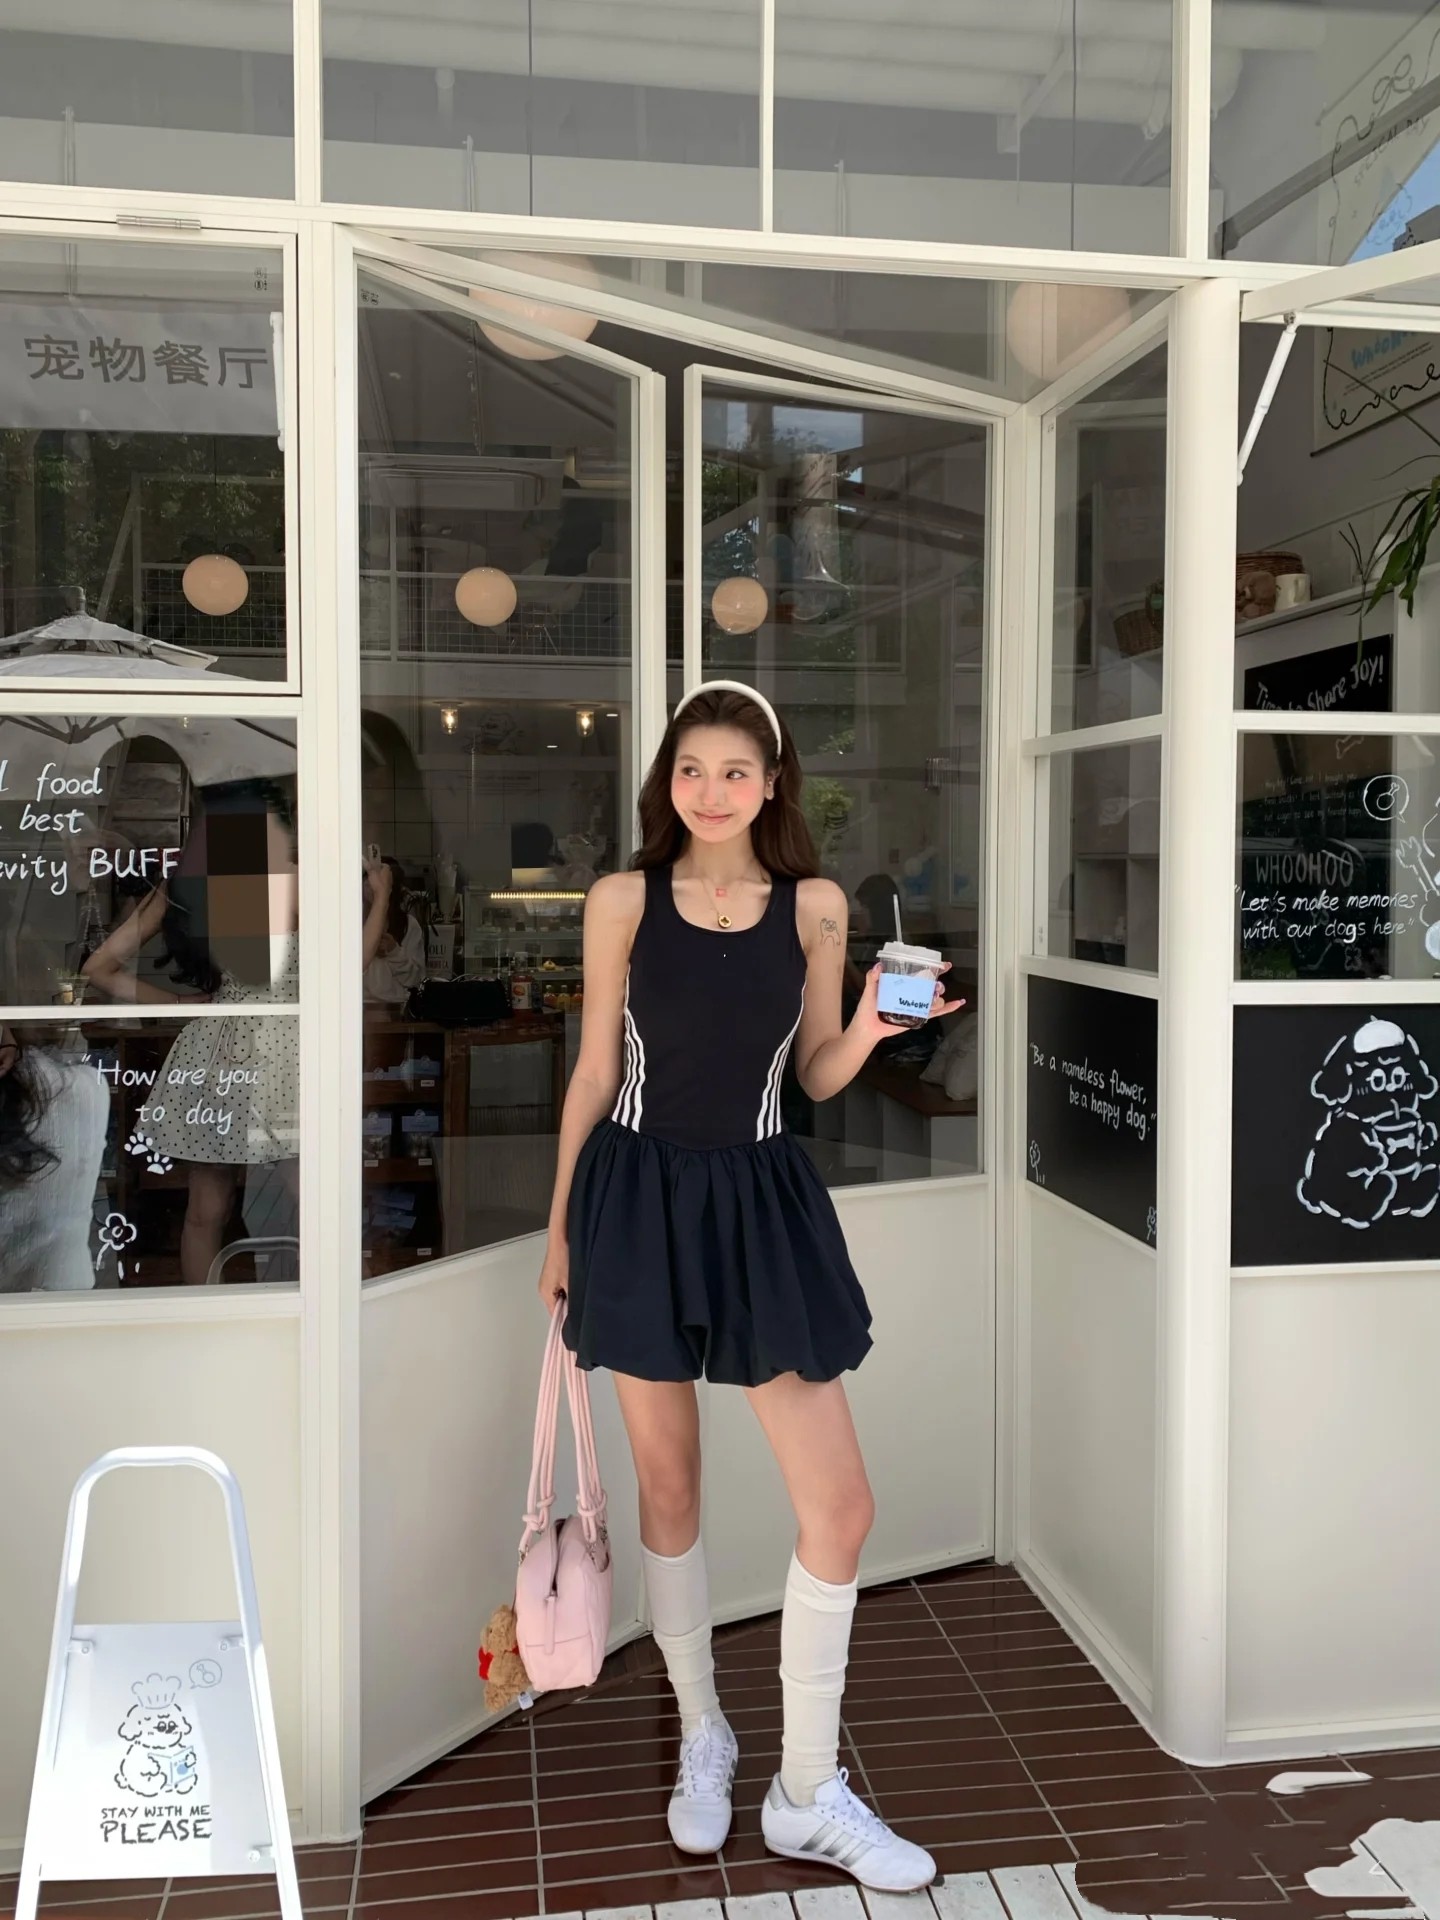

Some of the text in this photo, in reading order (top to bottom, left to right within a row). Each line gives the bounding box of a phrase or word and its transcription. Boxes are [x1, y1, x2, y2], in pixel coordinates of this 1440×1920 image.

[24, 334, 268, 389] 宠物餐厅
[1307, 676, 1347, 710] Share
[37, 762, 103, 801] food
[19, 804, 85, 833] best
[89, 848, 181, 879] BUFF
[1255, 851, 1354, 887] WHOOHOO
[1292, 889, 1339, 911] make
[1346, 893, 1418, 909] memories
[1243, 919, 1279, 940] with
[1287, 924, 1317, 938] our
[1324, 919, 1366, 943] dogs
[167, 1067, 207, 1086] are
[219, 1067, 259, 1096] you
[1049, 1056, 1057, 1071] a
[1061, 1057, 1105, 1089] nameless
[1109, 1069, 1147, 1105] flower,
[135, 1099, 233, 1135] to day
[1069, 1084, 1079, 1105] be
[1081, 1094, 1088, 1108] a
[1091, 1093, 1120, 1130] happy
[101, 1805, 211, 1819] STAY WITH ME
[100, 1819, 212, 1844] PLEASE
